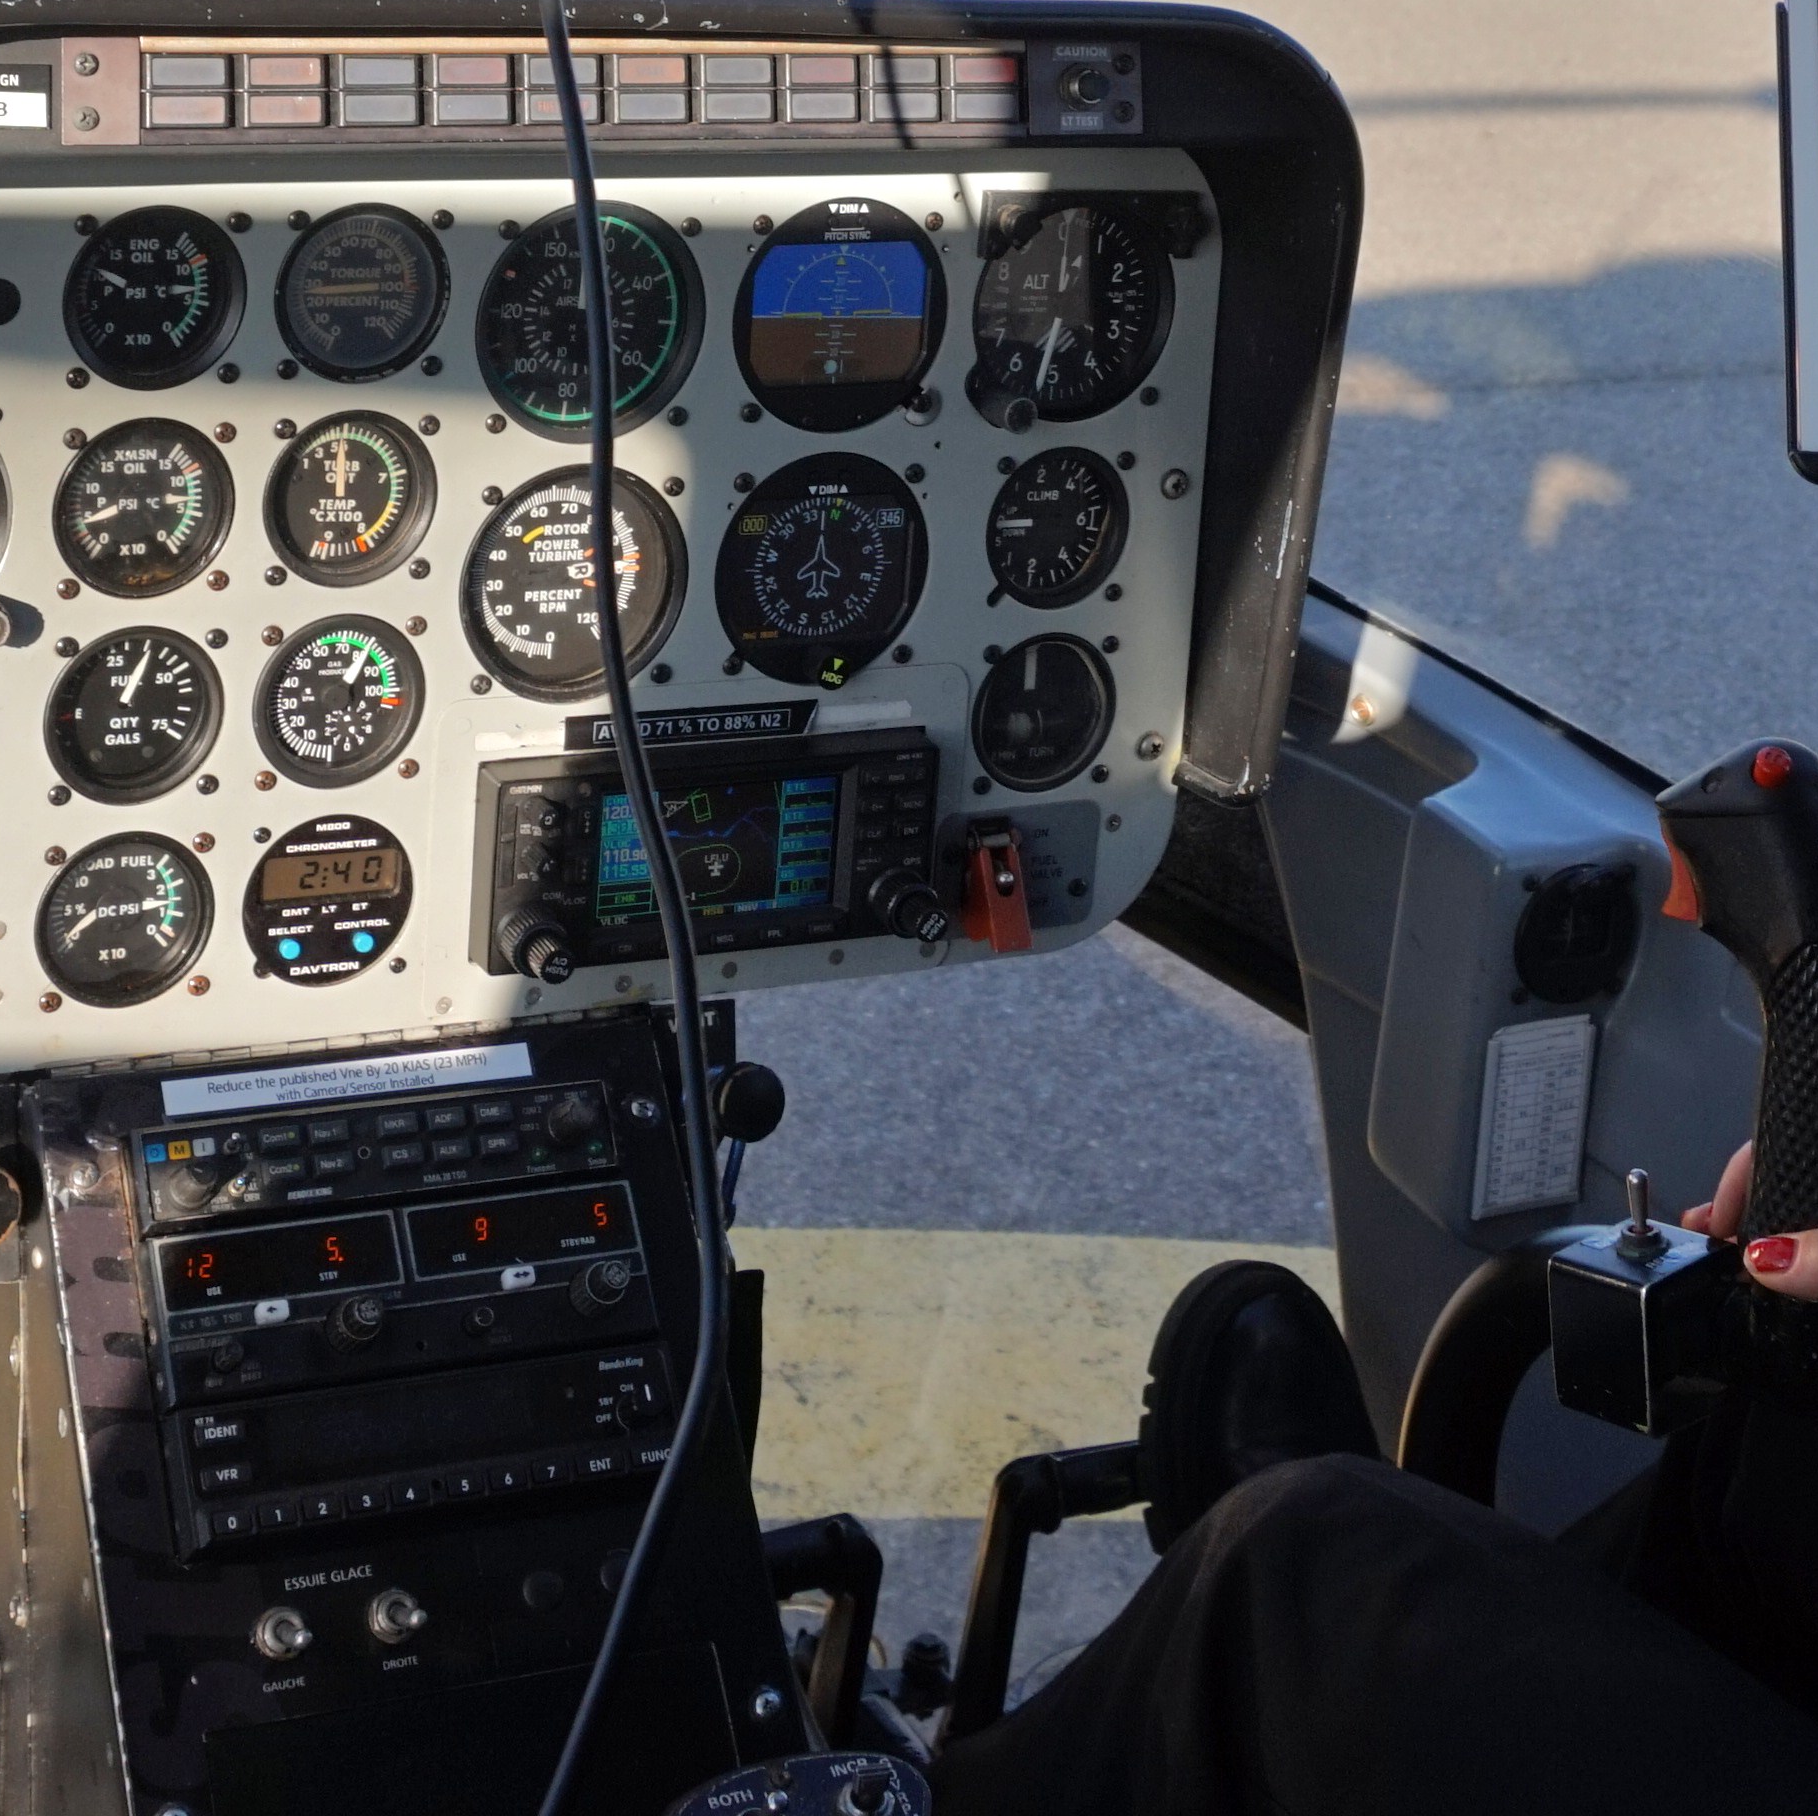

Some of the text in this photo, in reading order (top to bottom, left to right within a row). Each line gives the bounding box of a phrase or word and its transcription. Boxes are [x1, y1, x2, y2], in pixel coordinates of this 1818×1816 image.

[1056, 46, 1107, 56] CAUTION
[1075, 116, 1099, 126] TEST
[840, 204, 858, 213] DIM
[824, 231, 871, 241] PITCH SYNC
[130, 239, 160, 250] ENG
[131, 253, 154, 263] OIL
[330, 267, 381, 278] TORQUE
[1023, 274, 1049, 289] ALT
[126, 287, 146, 299] PSI
[325, 296, 380, 306] PERCENT
[114, 449, 157, 461] XMSN
[124, 463, 146, 474] OIL
[819, 486, 837, 495] DIM
[1027, 490, 1060, 501] CLIMB
[118, 499, 138, 510] PSI
[319, 499, 356, 510] TEMP
[561, 503, 578, 515] 70
[530, 507, 548, 518] 60
[880, 513, 901, 525] 346
[505, 525, 522, 537] 50
[543, 524, 589, 536] ROTOR
[533, 539, 579, 551] POWER
[489, 549, 507, 561] 40
[528, 550, 584, 563] TURBINE
[486, 579, 503, 592] 30
[524, 589, 582, 602] PERCENT
[495, 605, 513, 617] 20
[539, 602, 567, 613] RPM
[106, 655, 124, 667] 25
[155, 672, 173, 684] 50
[821, 670, 843, 685] HDG
[109, 717, 139, 729] QTY
[151, 719, 168, 730] 75
[289, 716, 305, 727] 20
[655, 722, 674, 736] 71
[697, 718, 720, 732] TO
[723, 715, 755, 730] 88%
[761, 713, 781, 727] N2
[105, 732, 141, 745] GALS
[510, 786, 542, 794] GARMIN
[286, 839, 377, 853] CHRONOMETER
[121, 856, 154, 867] FUEL
[300, 856, 382, 890] 2:40
[98, 904, 139, 918] DC PSI
[282, 902, 369, 917] GMT LT ET
[268, 925, 314, 936] SELECT
[334, 919, 390, 930] CONTROL
[290, 962, 360, 976] DAVTRON
[207, 1053, 487, 1094] Reduce the published Vne By 20 KIAS (23 MPH)
[276, 1074, 435, 1101] with Camera/Sensor Installed
[480, 1106, 500, 1117] DME
[434, 1113, 453, 1124] ADF
[392, 1148, 409, 1159] ICS
[593, 1203, 607, 1227] 5
[475, 1217, 489, 1242] 9
[187, 1253, 214, 1279] 12
[319, 1271, 339, 1281] STBY
[206, 1285, 222, 1296] USE
[595, 1413, 612, 1424] OFF
[203, 1424, 238, 1440] IDENT
[641, 1447, 671, 1464] FUNC
[589, 1457, 611, 1471] ENT
[216, 1468, 238, 1481] VFR
[546, 1465, 556, 1479] 7
[462, 1479, 471, 1492] 5
[504, 1473, 514, 1486] 6
[406, 1487, 415, 1501] 4
[362, 1495, 372, 1507] 3
[318, 1502, 328, 1515] 2
[275, 1509, 283, 1522] 1
[227, 1517, 237, 1529] 0
[284, 1565, 374, 1591] ESSUIE GLACE
[382, 1655, 419, 1671] DROITE
[262, 1676, 305, 1693] GAUCHE
[707, 1790, 754, 1810] BOTH
